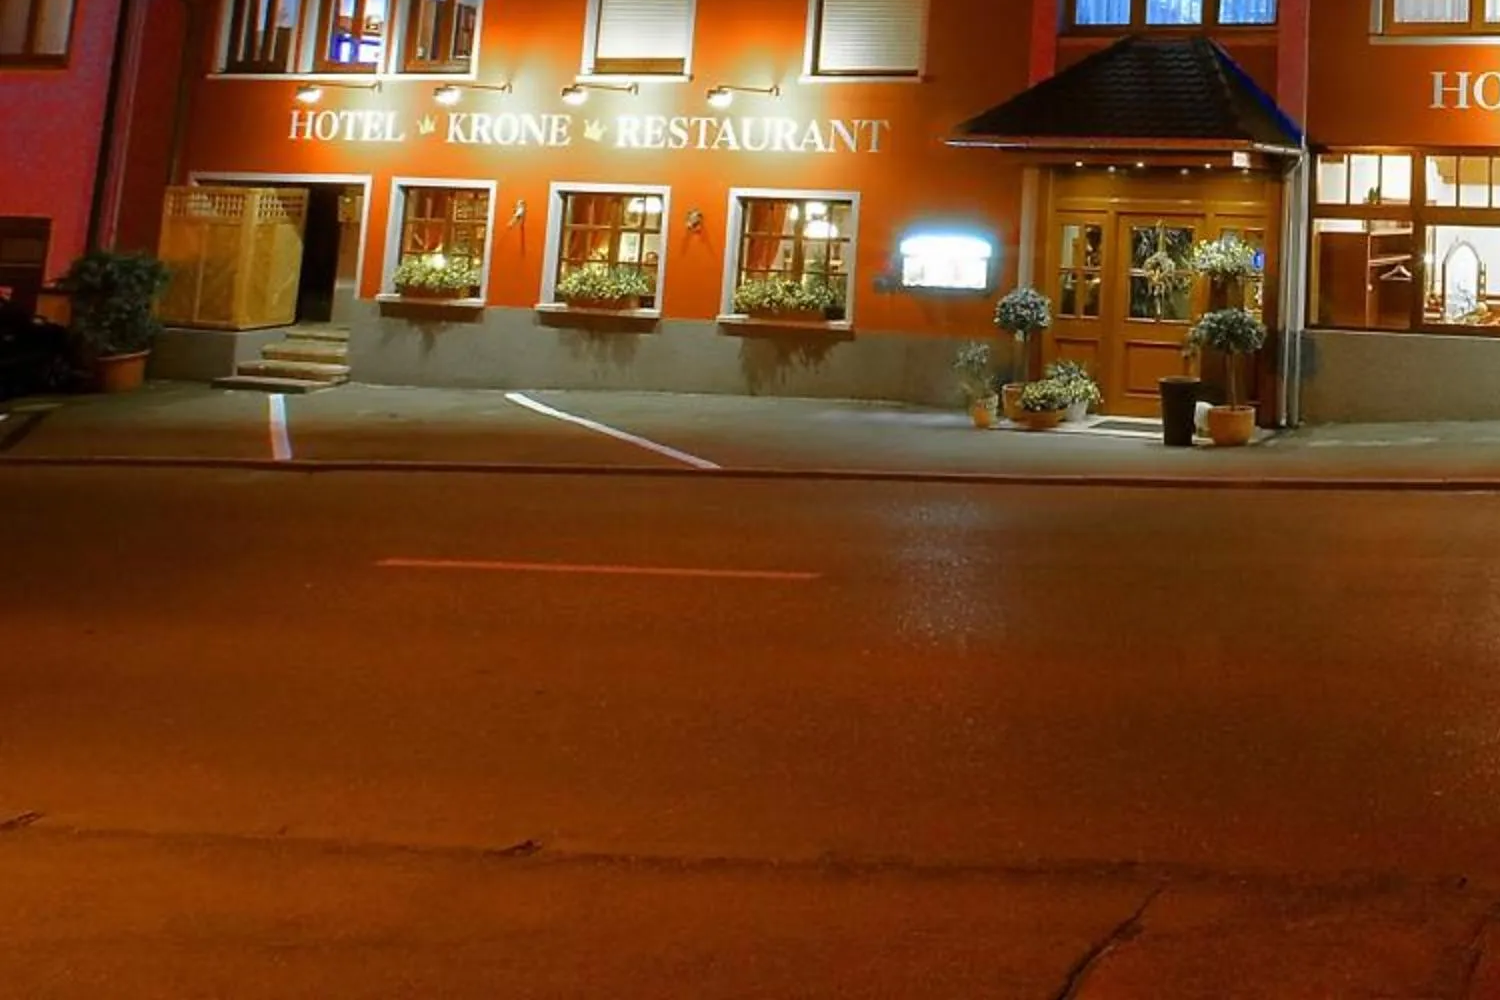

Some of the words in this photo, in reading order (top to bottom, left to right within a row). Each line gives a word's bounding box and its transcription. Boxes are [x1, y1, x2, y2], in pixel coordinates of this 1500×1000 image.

[287, 109, 406, 143] HOTEL
[446, 112, 572, 146] KRONE
[614, 115, 892, 153] RESTAURANT
